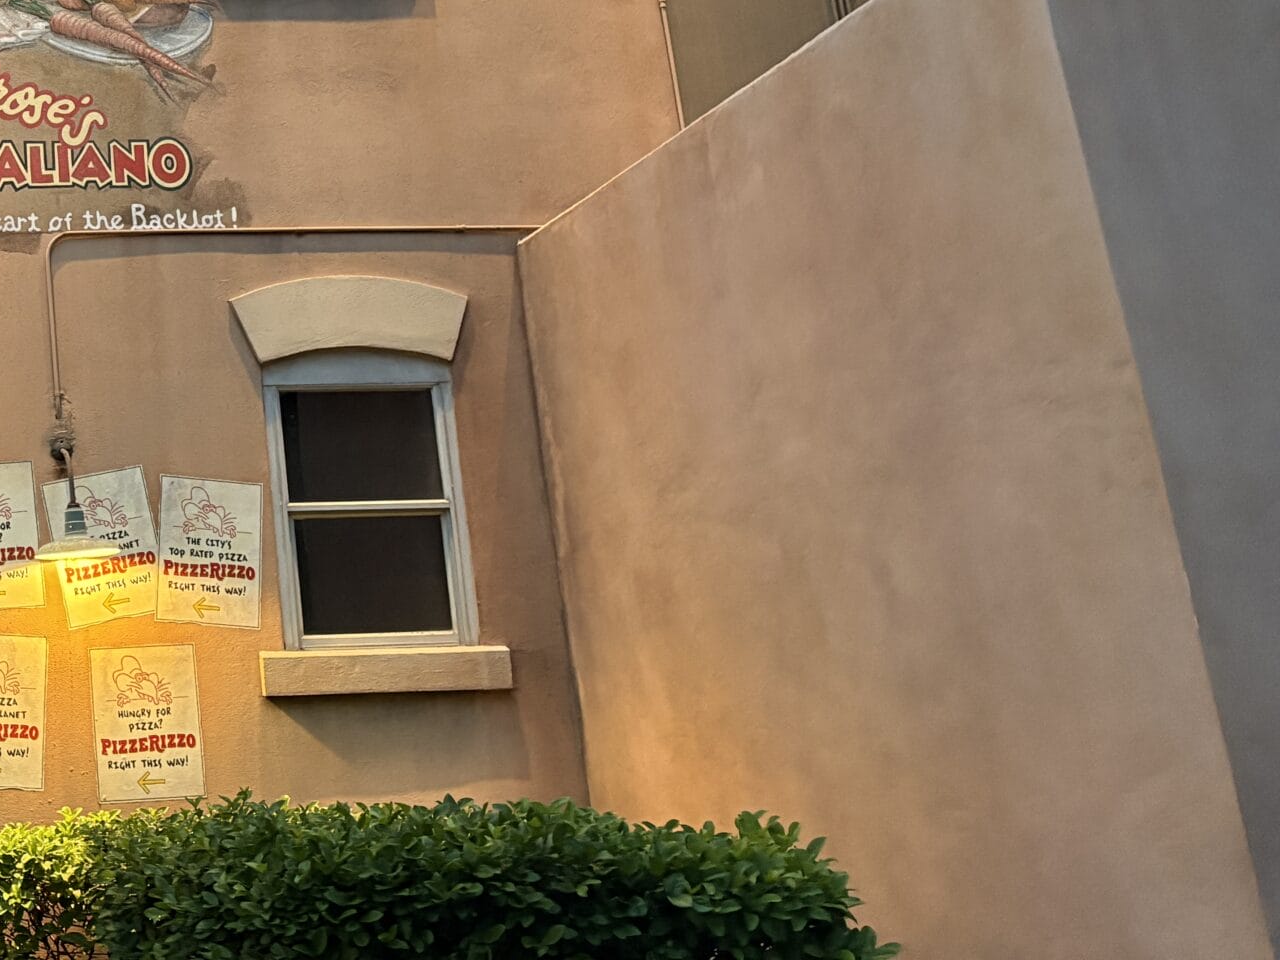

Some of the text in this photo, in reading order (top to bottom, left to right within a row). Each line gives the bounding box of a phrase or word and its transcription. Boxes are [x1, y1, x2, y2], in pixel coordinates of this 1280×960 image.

[47, 212, 73, 232] of
[83, 210, 125, 230] the
[130, 203, 238, 230] Backlot!
[118, 539, 140, 550] ANET
[186, 537, 231, 549] THE CITY'S
[169, 547, 248, 562] TOP RATED PIZZA
[7, 568, 28, 578] WAY!
[74, 572, 151, 595] RIGHT THIS WAY!
[168, 581, 246, 596] RIGHT THIS WAY!
[118, 707, 171, 718] HUNGRY FOR
[128, 719, 163, 732] PIZZA?
[7, 747, 29, 758] WAY!
[108, 755, 188, 771] RIGHT THIS WAY!
